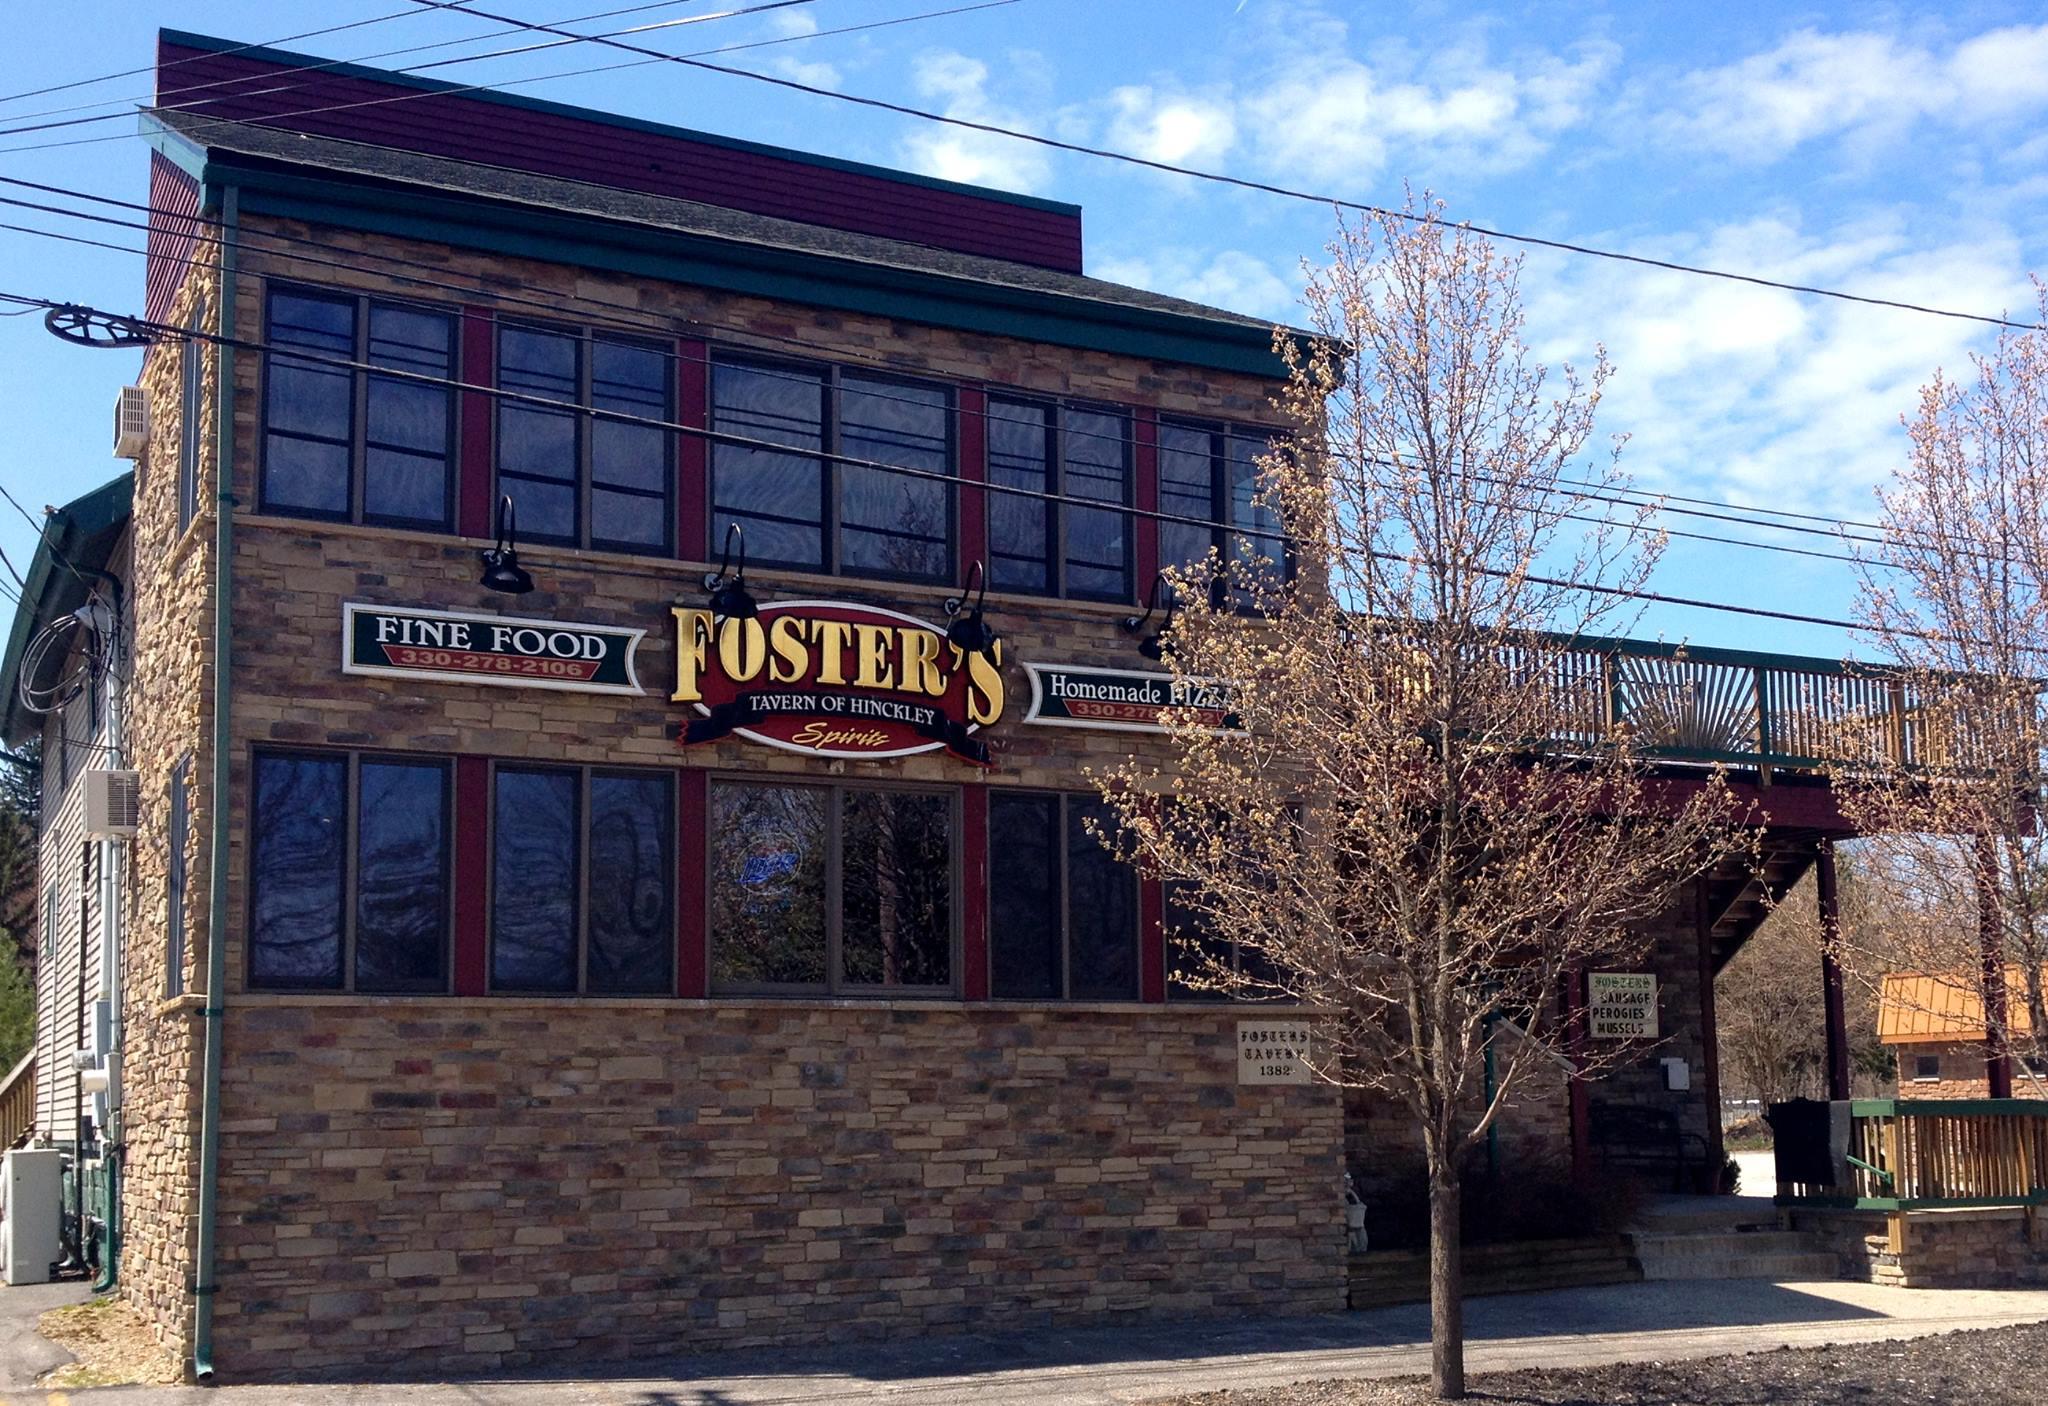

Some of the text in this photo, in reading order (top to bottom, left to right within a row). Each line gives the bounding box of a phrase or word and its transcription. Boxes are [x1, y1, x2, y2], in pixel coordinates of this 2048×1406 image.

[375, 616, 607, 660] FINE FOOD
[402, 649, 583, 676] 330-278-2106
[670, 606, 1005, 727] FOSTER'S
[1050, 674, 1161, 704] Homemade
[750, 695, 936, 726] TAVERN OF HINCKLEY
[791, 722, 891, 751] Spirits
[1600, 992, 1650, 1004] SAUSAGE
[1592, 1007, 1645, 1019] PEROGIES
[1241, 1031, 1308, 1043] FOSTERS
[1597, 1022, 1644, 1034] MUSSELS
[1260, 1065, 1291, 1076] 1382
